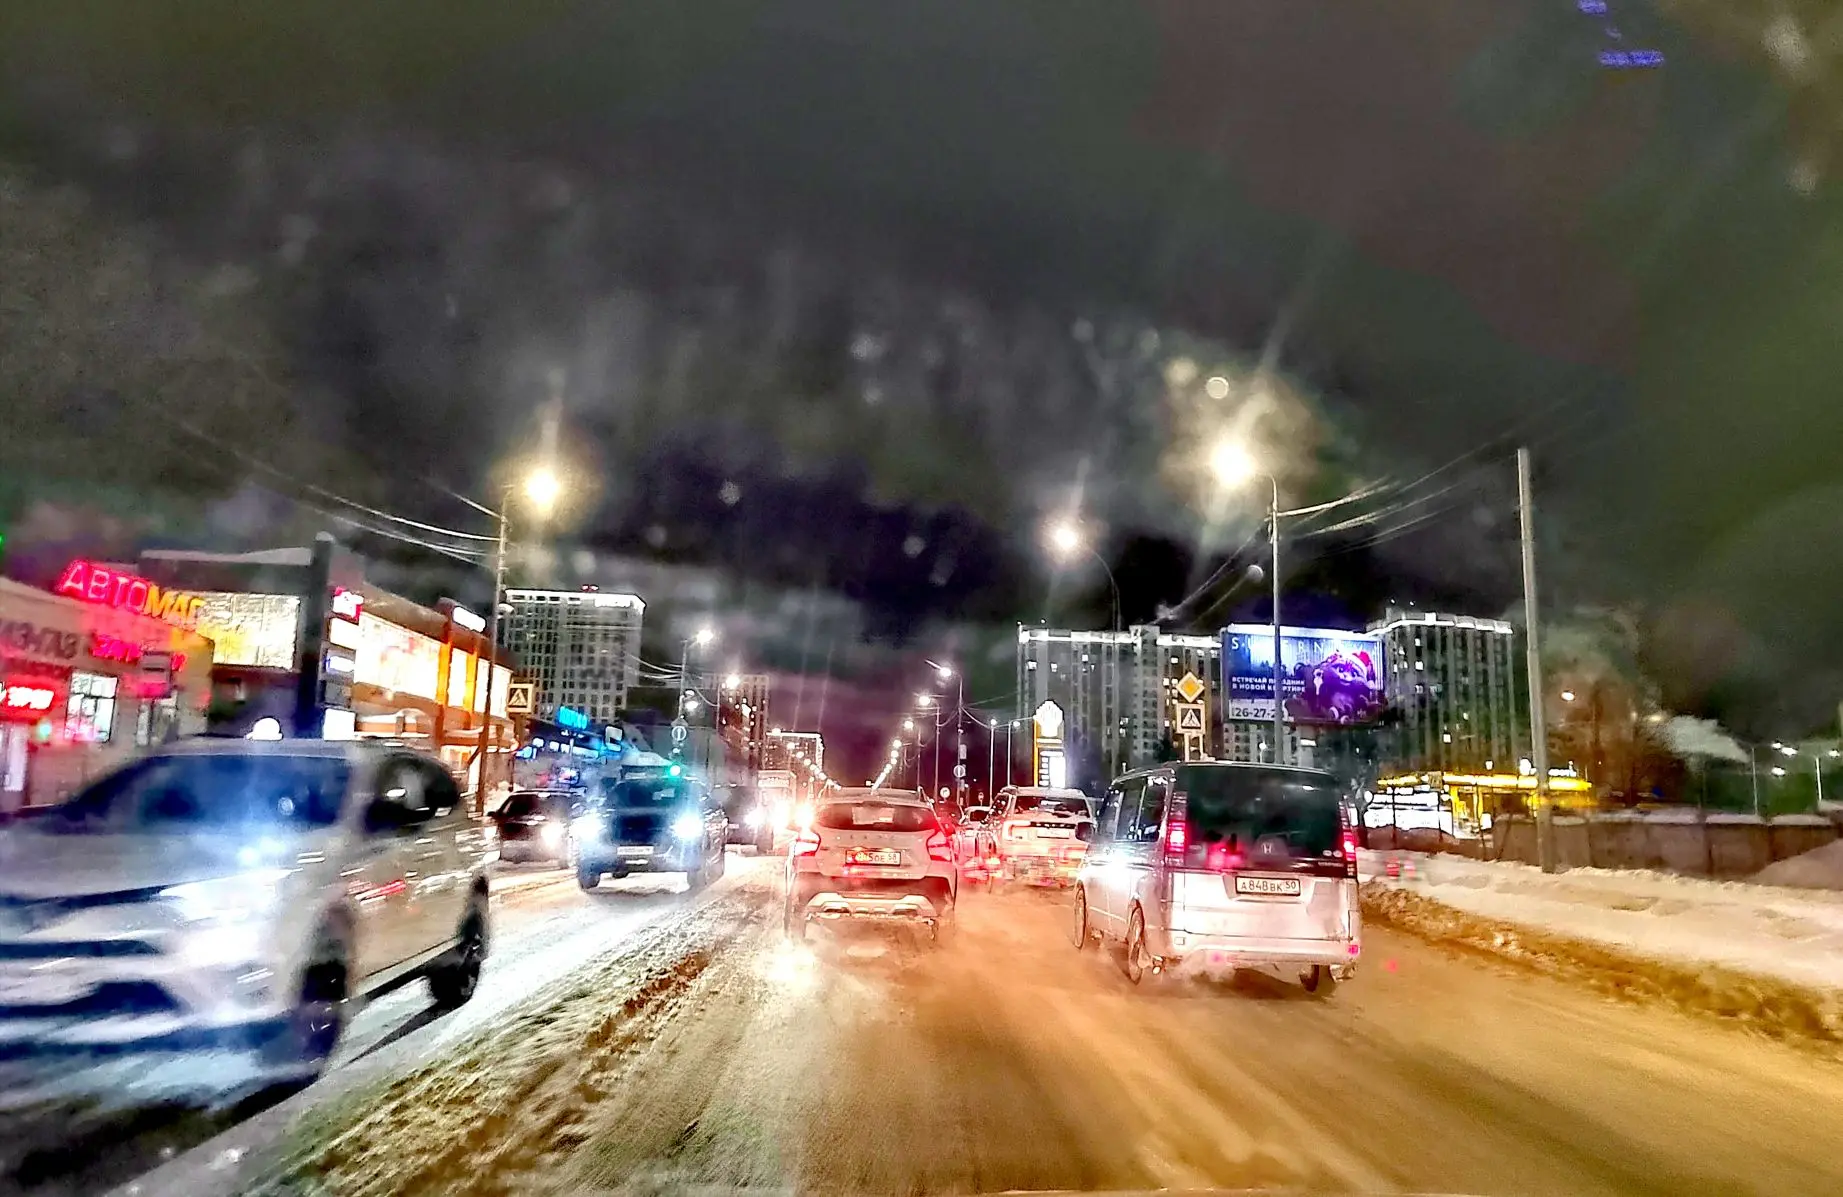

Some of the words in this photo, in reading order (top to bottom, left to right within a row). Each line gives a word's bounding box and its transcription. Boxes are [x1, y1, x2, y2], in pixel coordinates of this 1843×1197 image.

[1231, 676, 1268, 684] ВСТРЕЧАЙ
[1268, 678, 1305, 686] ПЗДНИК
[1267, 685, 1306, 693] КРТИРЕ
